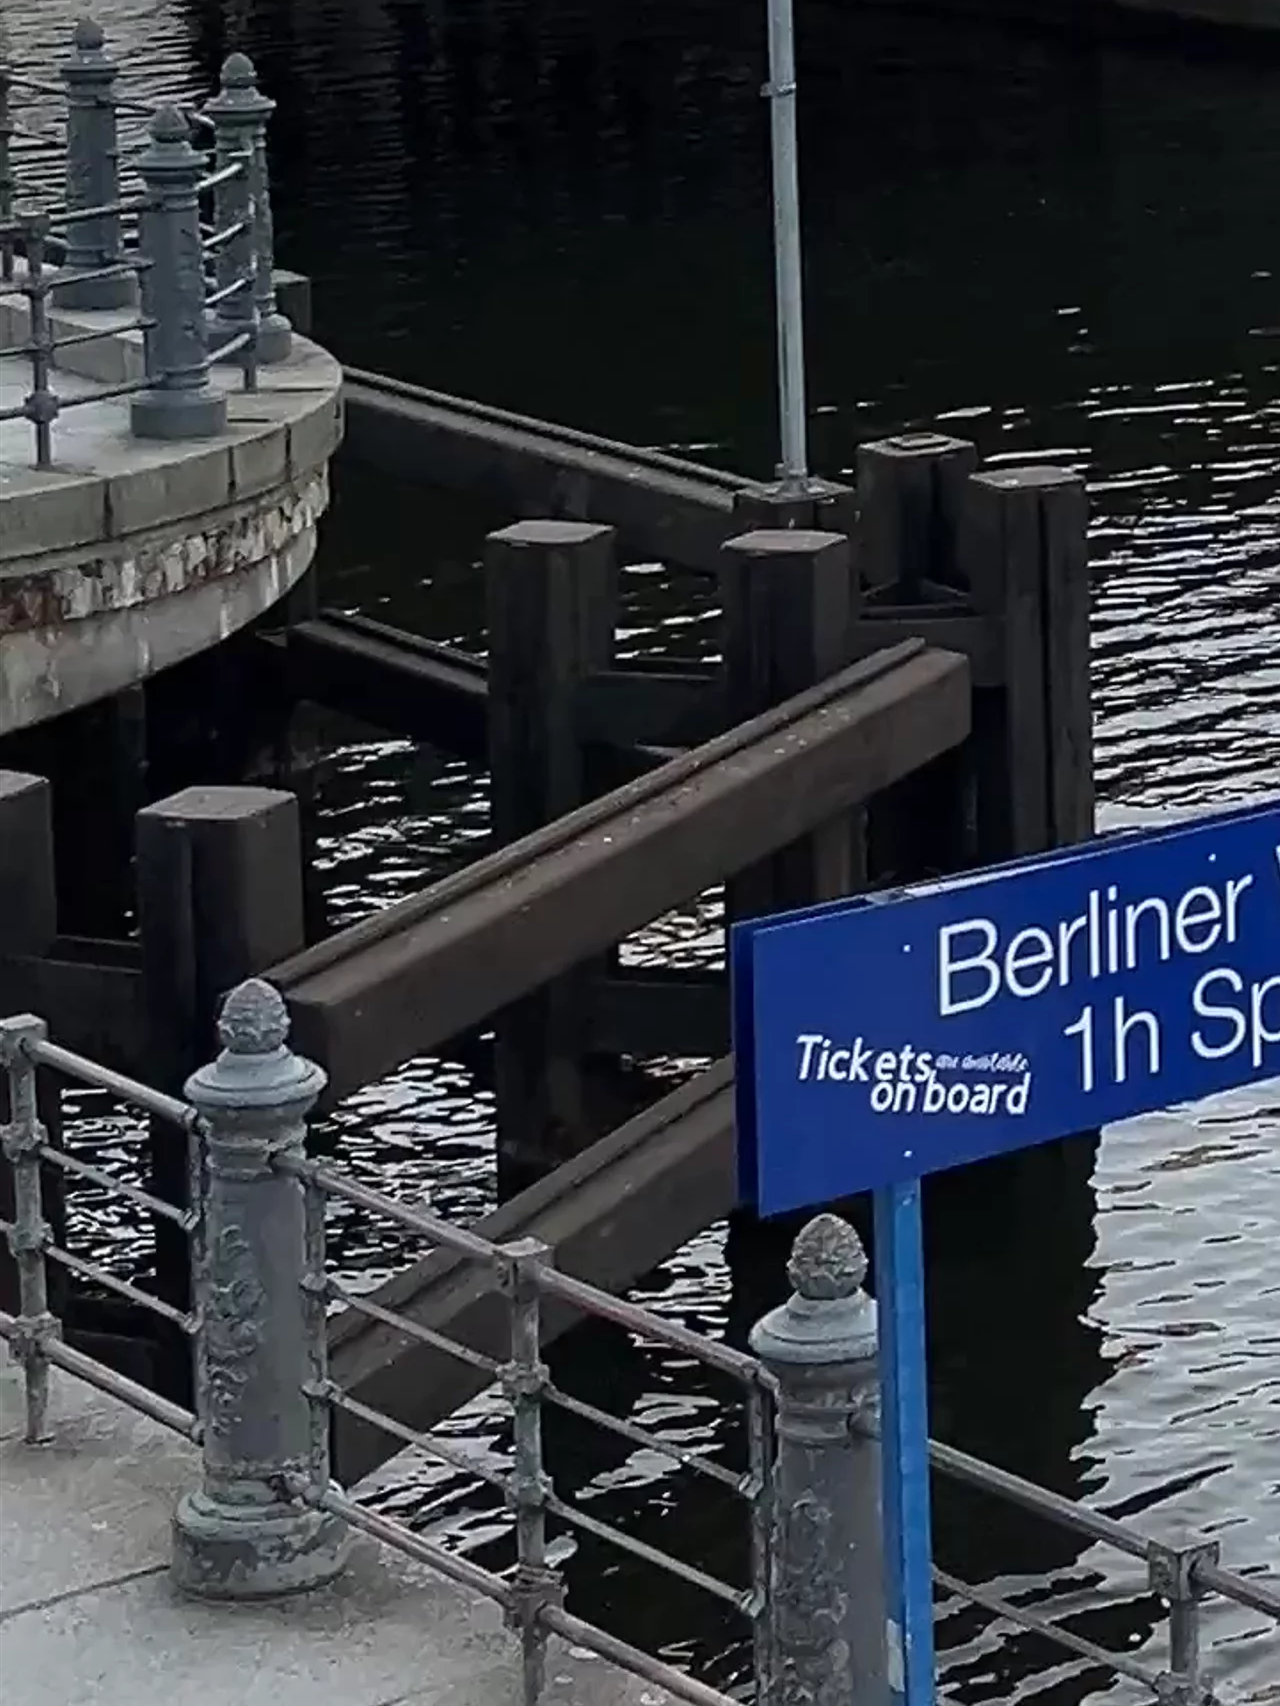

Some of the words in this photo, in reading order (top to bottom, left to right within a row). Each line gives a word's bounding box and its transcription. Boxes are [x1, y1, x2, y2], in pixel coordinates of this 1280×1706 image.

[939, 874, 1253, 1016] Berliner
[797, 1034, 933, 1082] Tickets
[1064, 996, 1159, 1092] 1h
[870, 1080, 917, 1113] on
[922, 1070, 1031, 1115] board
